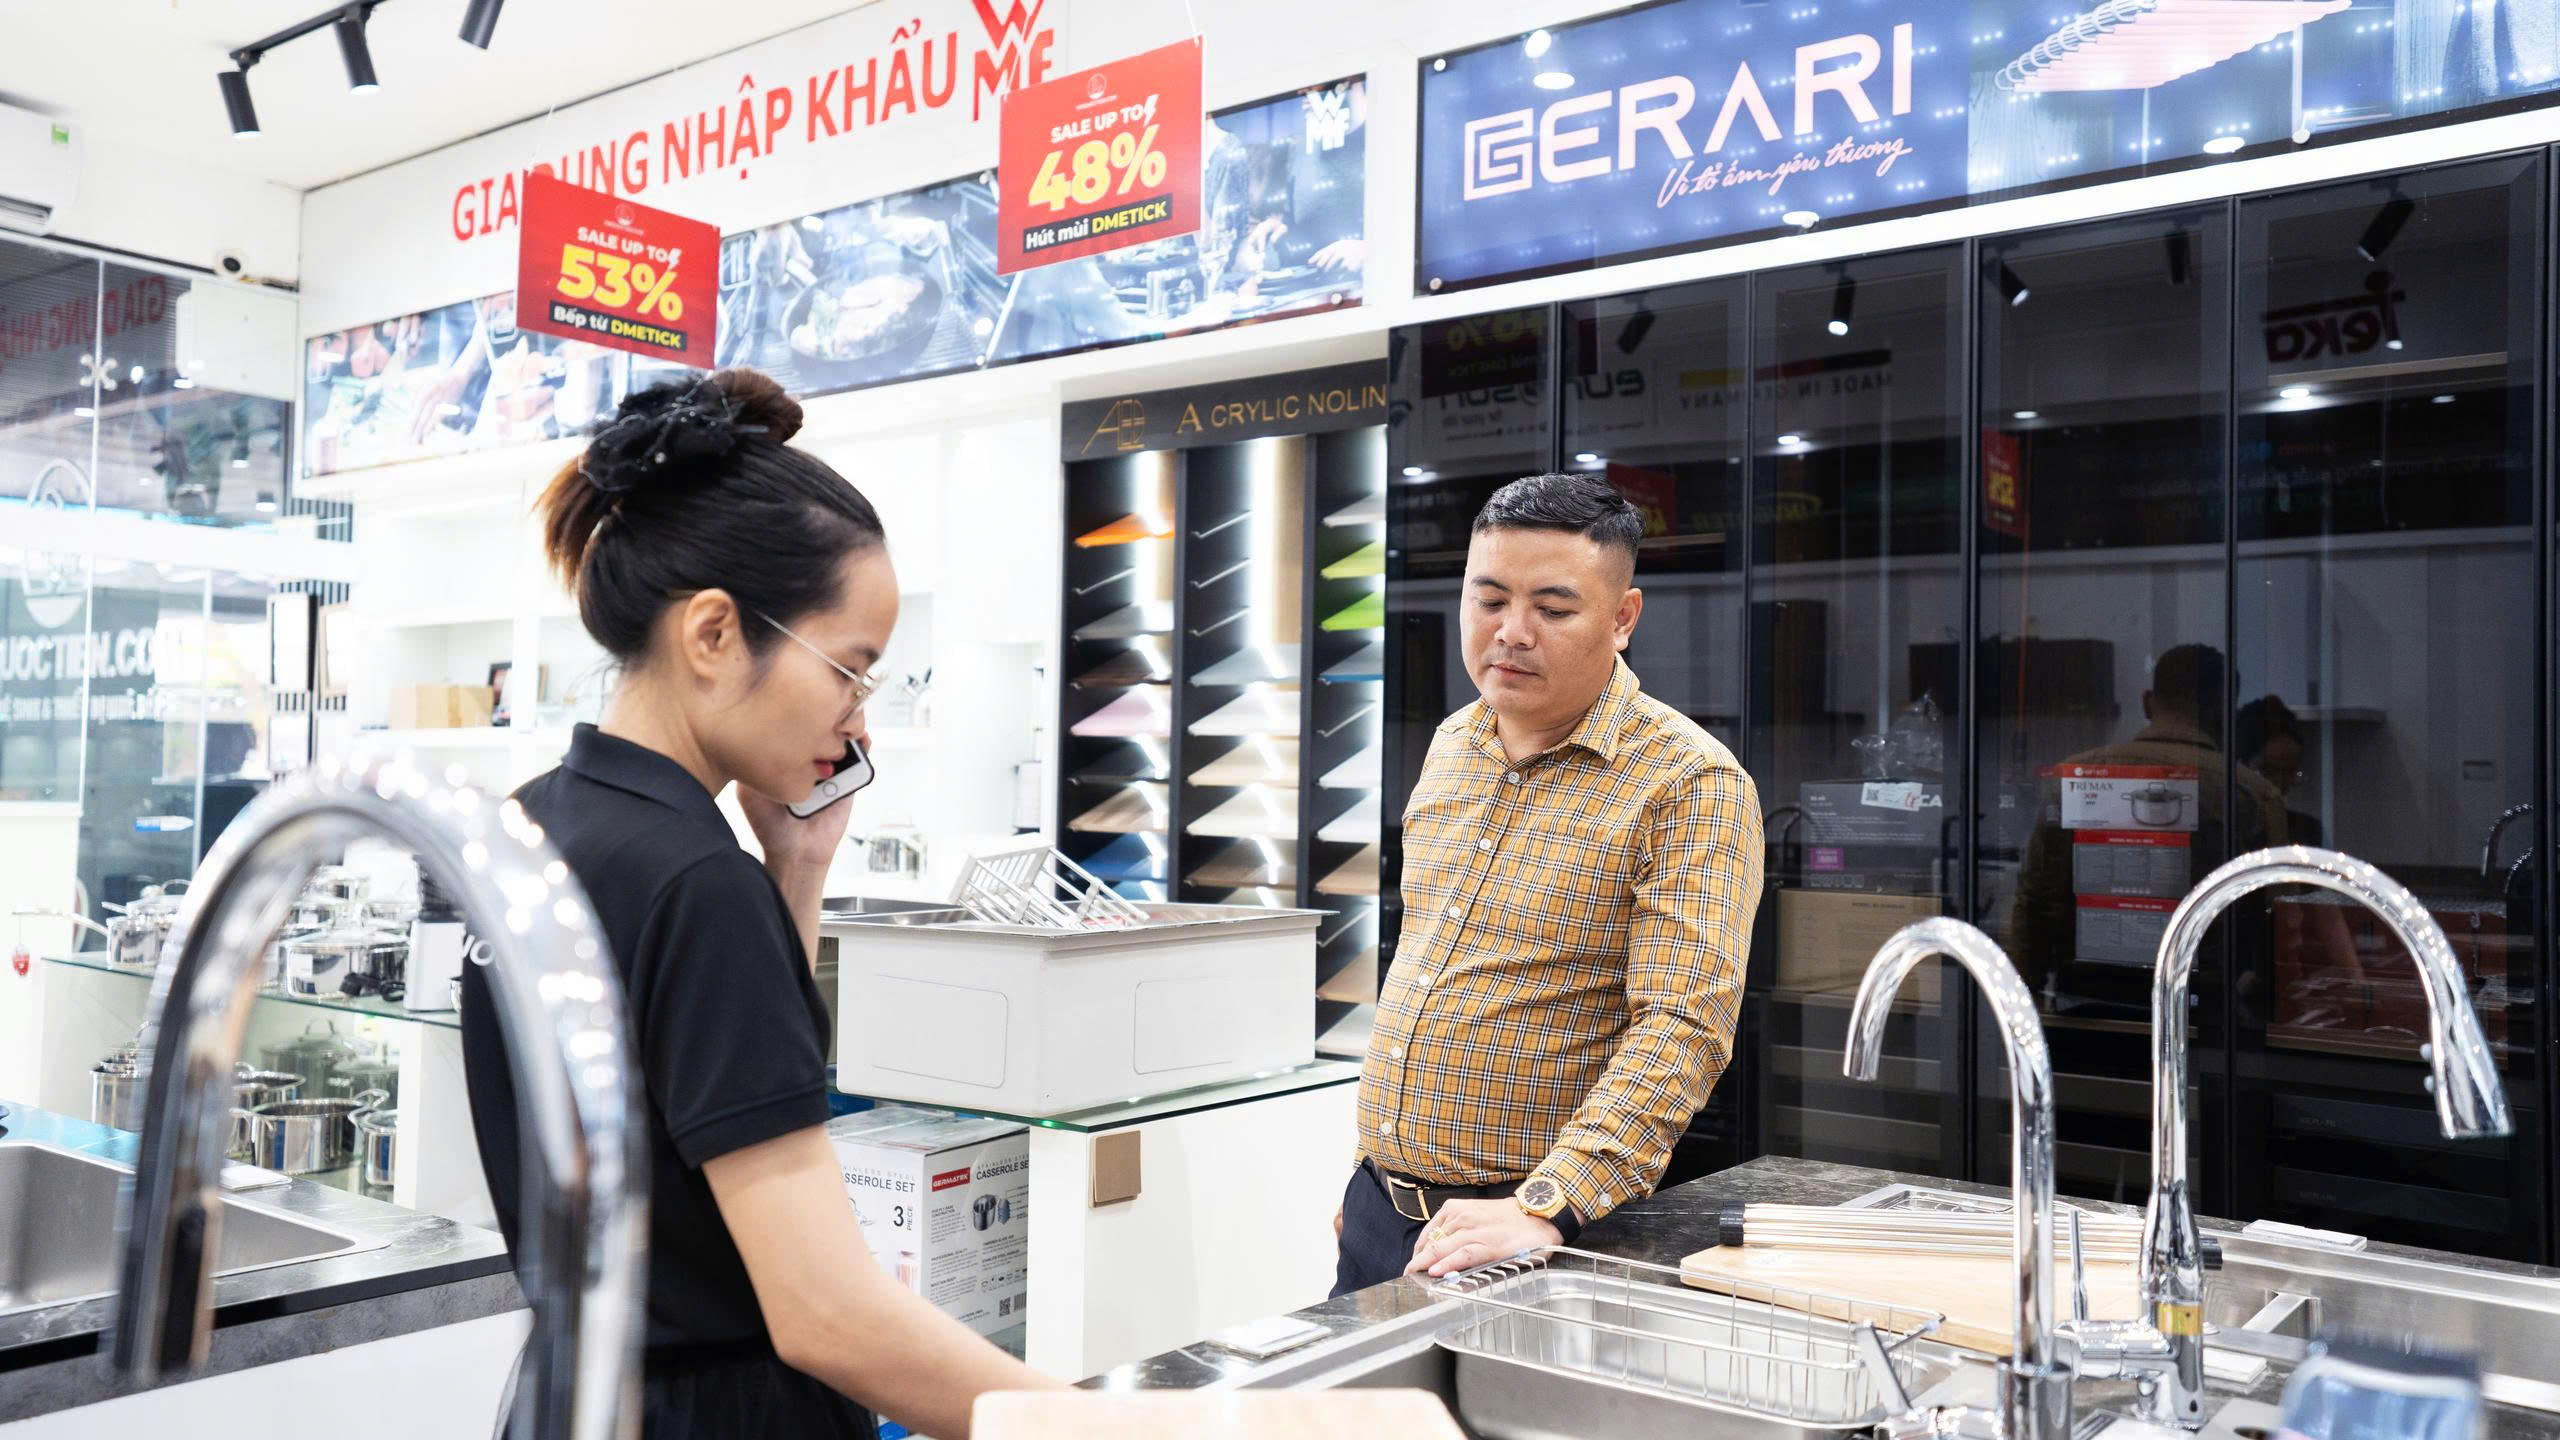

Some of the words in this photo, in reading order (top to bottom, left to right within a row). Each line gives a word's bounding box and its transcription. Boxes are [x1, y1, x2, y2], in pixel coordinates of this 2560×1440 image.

[453, 173, 518, 241] GIA
[662, 74, 793, 185] NHẬP
[806, 18, 958, 143] KHẨU
[1050, 118, 1092, 144] SALE
[1094, 110, 1118, 132] UP
[1120, 103, 1145, 124] TO
[1463, 22, 1913, 201] GERARI
[1027, 123, 1168, 213] 48%
[577, 226, 619, 250] SALE
[621, 239, 645, 255] UP
[646, 245, 670, 264] TO
[1025, 229, 1056, 249] Hút
[1057, 219, 1089, 242] mùi
[1091, 200, 1168, 234] DMETICK
[556, 243, 684, 322] 53%
[553, 305, 588, 328] Bếp
[610, 318, 682, 349] DMETICK
[1176, 402, 1204, 434] A
[1210, 395, 1301, 428] CRYLIC
[895, 1180, 916, 1193] SET
[932, 1173, 969, 1188] GERMATEK
[976, 1162, 1019, 1181] CASSEROLE
[893, 1205, 904, 1227] 3
